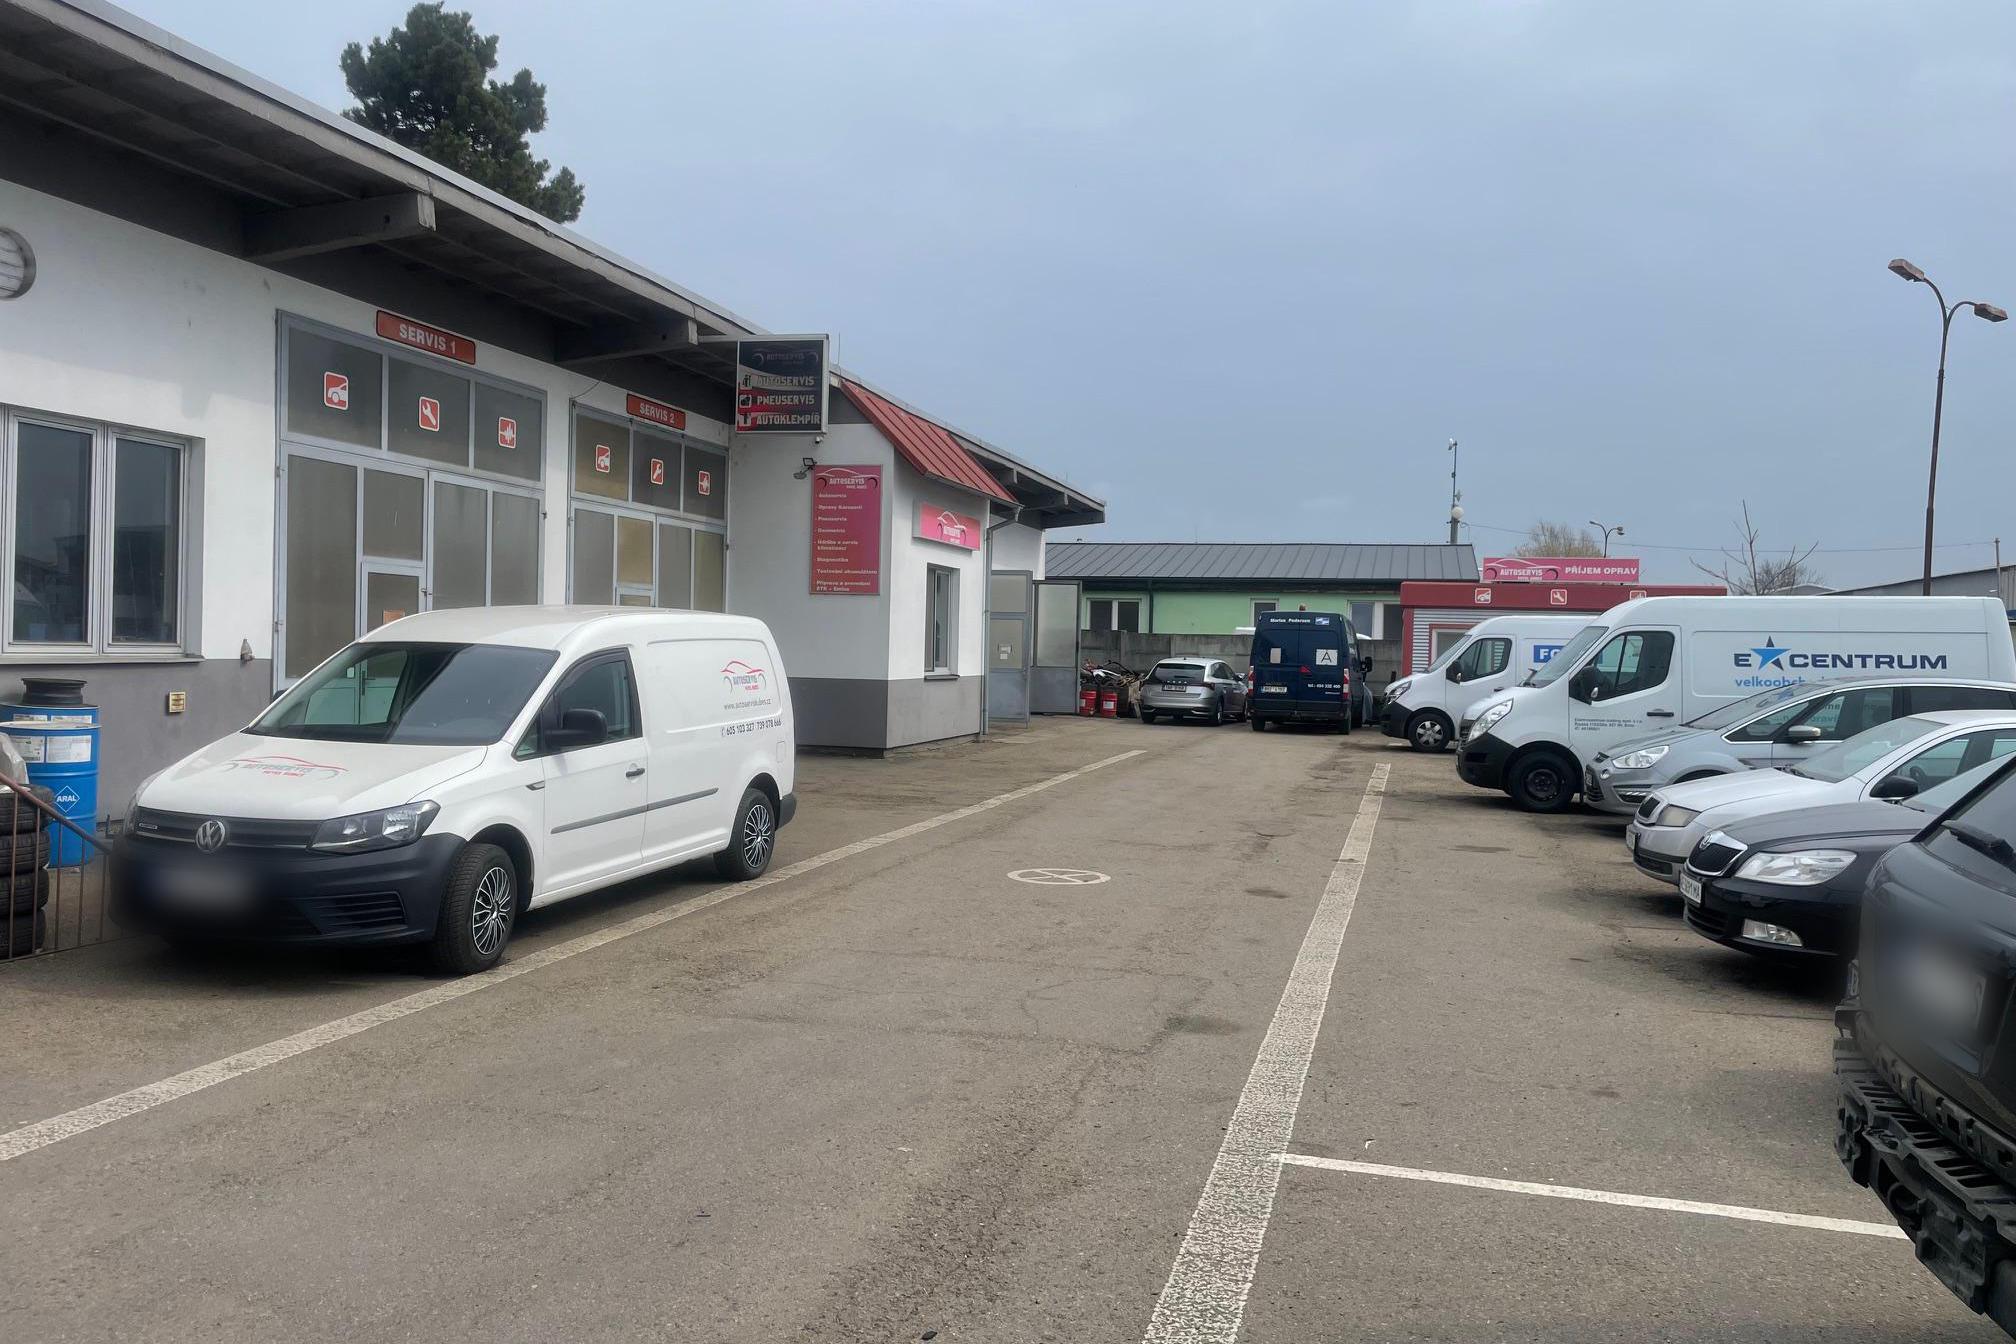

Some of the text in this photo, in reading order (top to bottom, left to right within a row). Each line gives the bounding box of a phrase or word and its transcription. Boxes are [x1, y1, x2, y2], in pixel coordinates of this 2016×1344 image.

[399, 323, 456, 354] SERVIS 1
[756, 375, 815, 386] AUTOSERVIS
[756, 395, 815, 405] PNEUSERVIS
[640, 402, 675, 424] SERVIS 2
[1500, 565, 1638, 576] AUTOSERVIS PŘÍJEM OPRAV
[1321, 651, 1332, 663] A
[56, 795, 77, 803] ARAL
